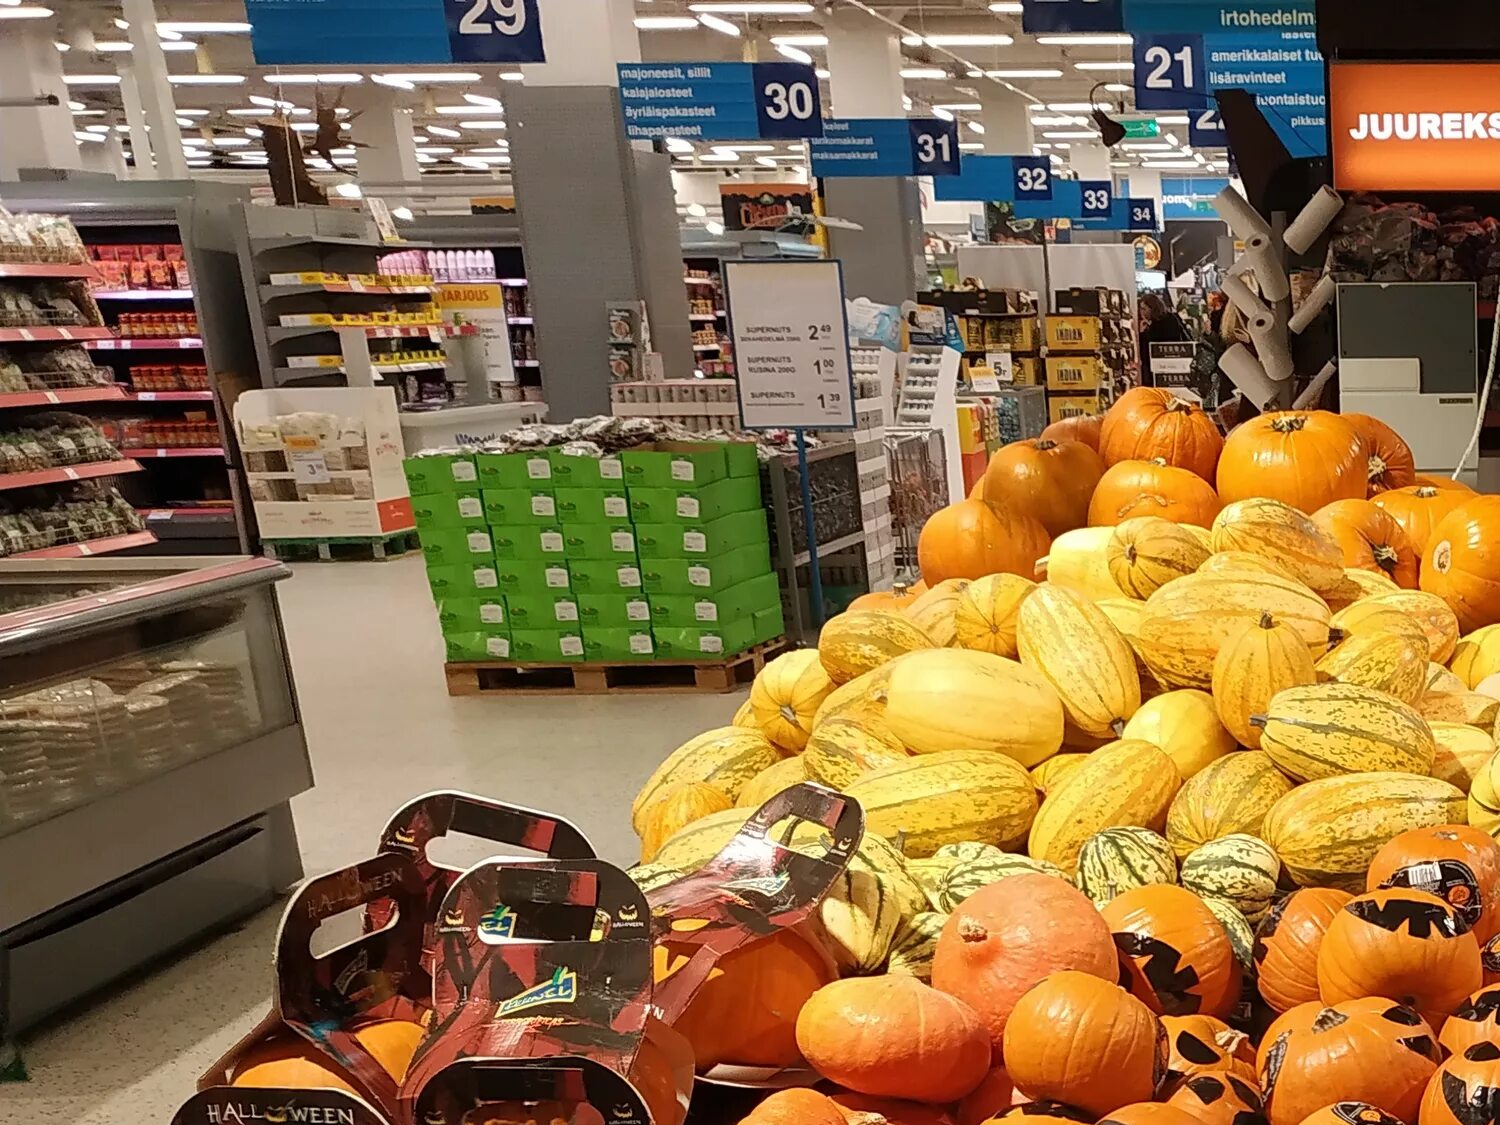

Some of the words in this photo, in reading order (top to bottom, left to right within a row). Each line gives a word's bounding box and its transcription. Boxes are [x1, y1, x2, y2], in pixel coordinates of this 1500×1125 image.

[459, 0, 526, 35] 29
[1220, 9, 1316, 26] irtohedelm
[1211, 49, 1302, 62] amerikkalaiset
[621, 67, 685, 80] majoneesit,
[687, 66, 711, 79] sillit
[1144, 46, 1193, 89] 21
[1209, 71, 1287, 84] lisäravinteet
[622, 86, 693, 100] kalajalosteet
[764, 82, 814, 120] 30
[625, 105, 716, 119] äyriäispakasteet
[627, 124, 703, 139] lihapakasteet
[917, 133, 951, 163] 31
[1017, 167, 1048, 192] 32
[1084, 189, 1109, 211] 33
[1133, 207, 1151, 221] 34
[808, 325, 820, 341] 2
[813, 359, 822, 375] 1
[817, 394, 826, 409] 1
